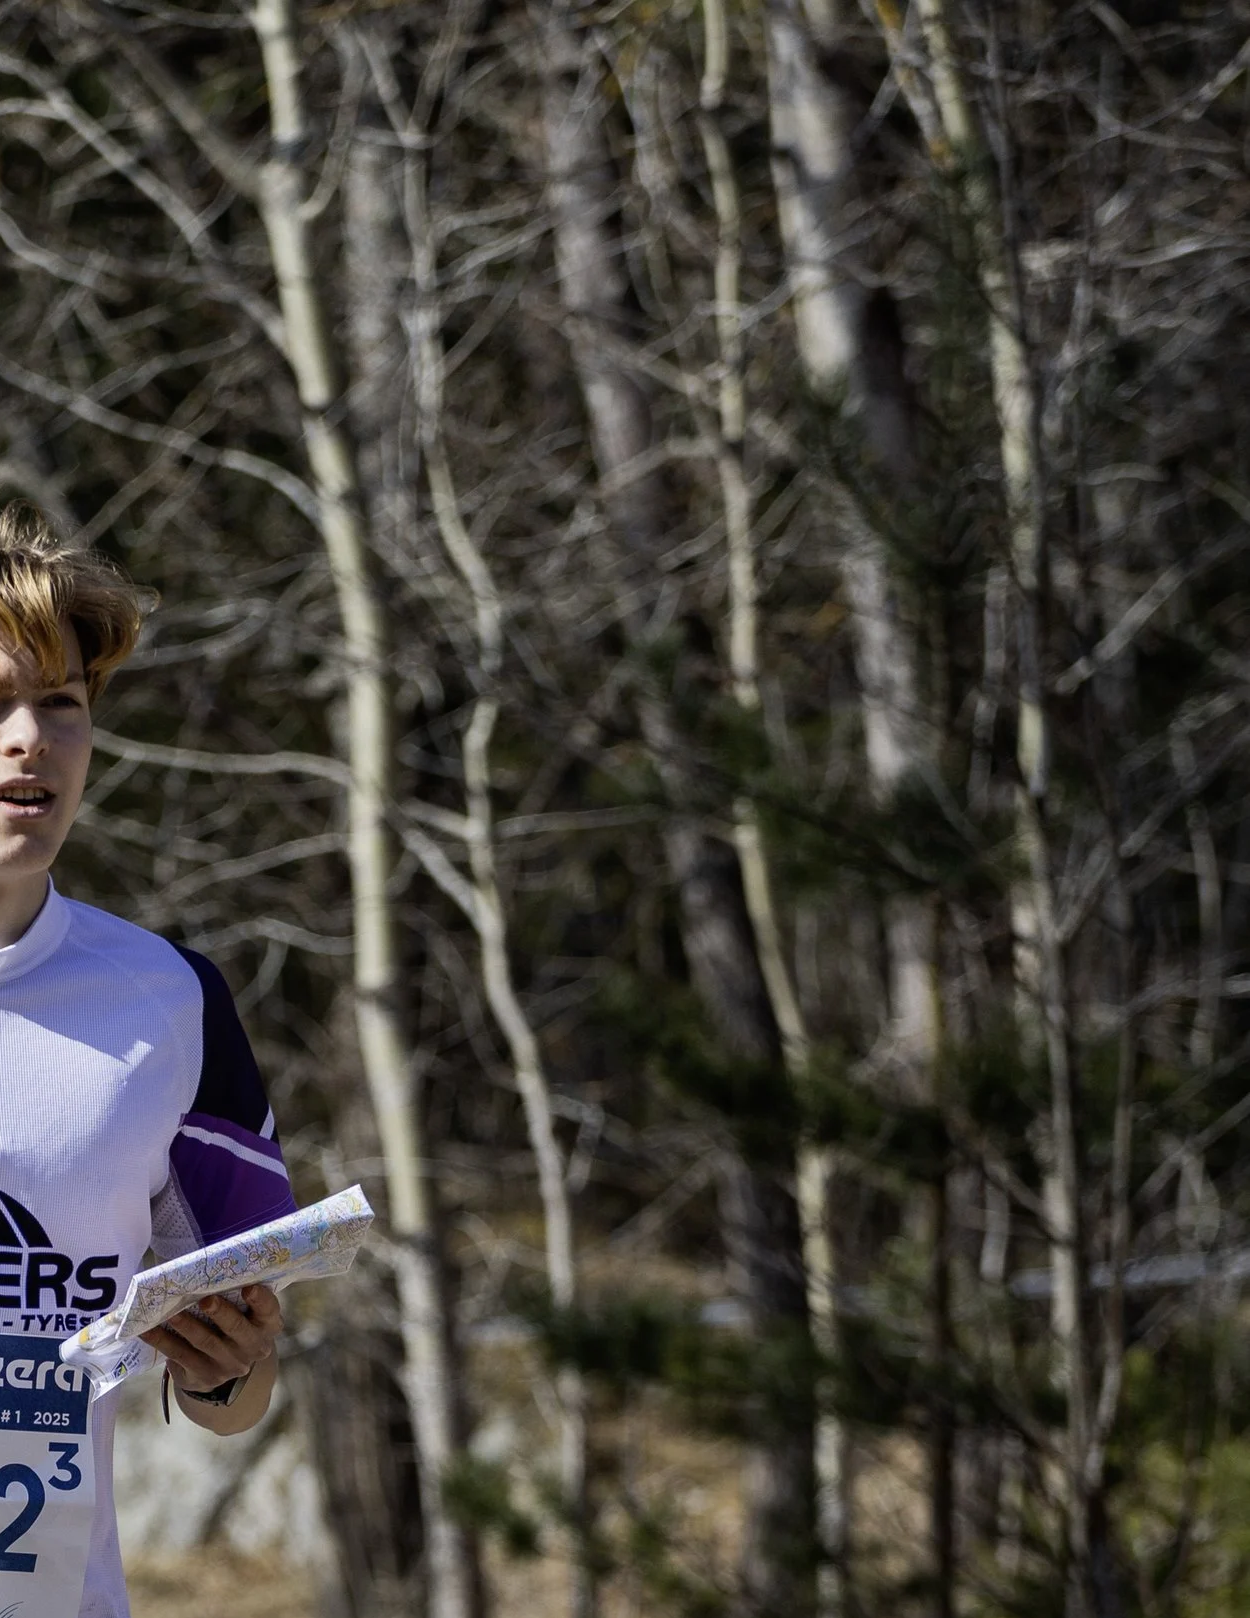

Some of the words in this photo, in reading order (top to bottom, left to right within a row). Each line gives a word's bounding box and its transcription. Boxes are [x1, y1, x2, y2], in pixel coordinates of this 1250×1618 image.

[21, 1312, 110, 1332] TYRES
[33, 1411, 71, 1427] 2025
[48, 1442, 82, 1491] 3
